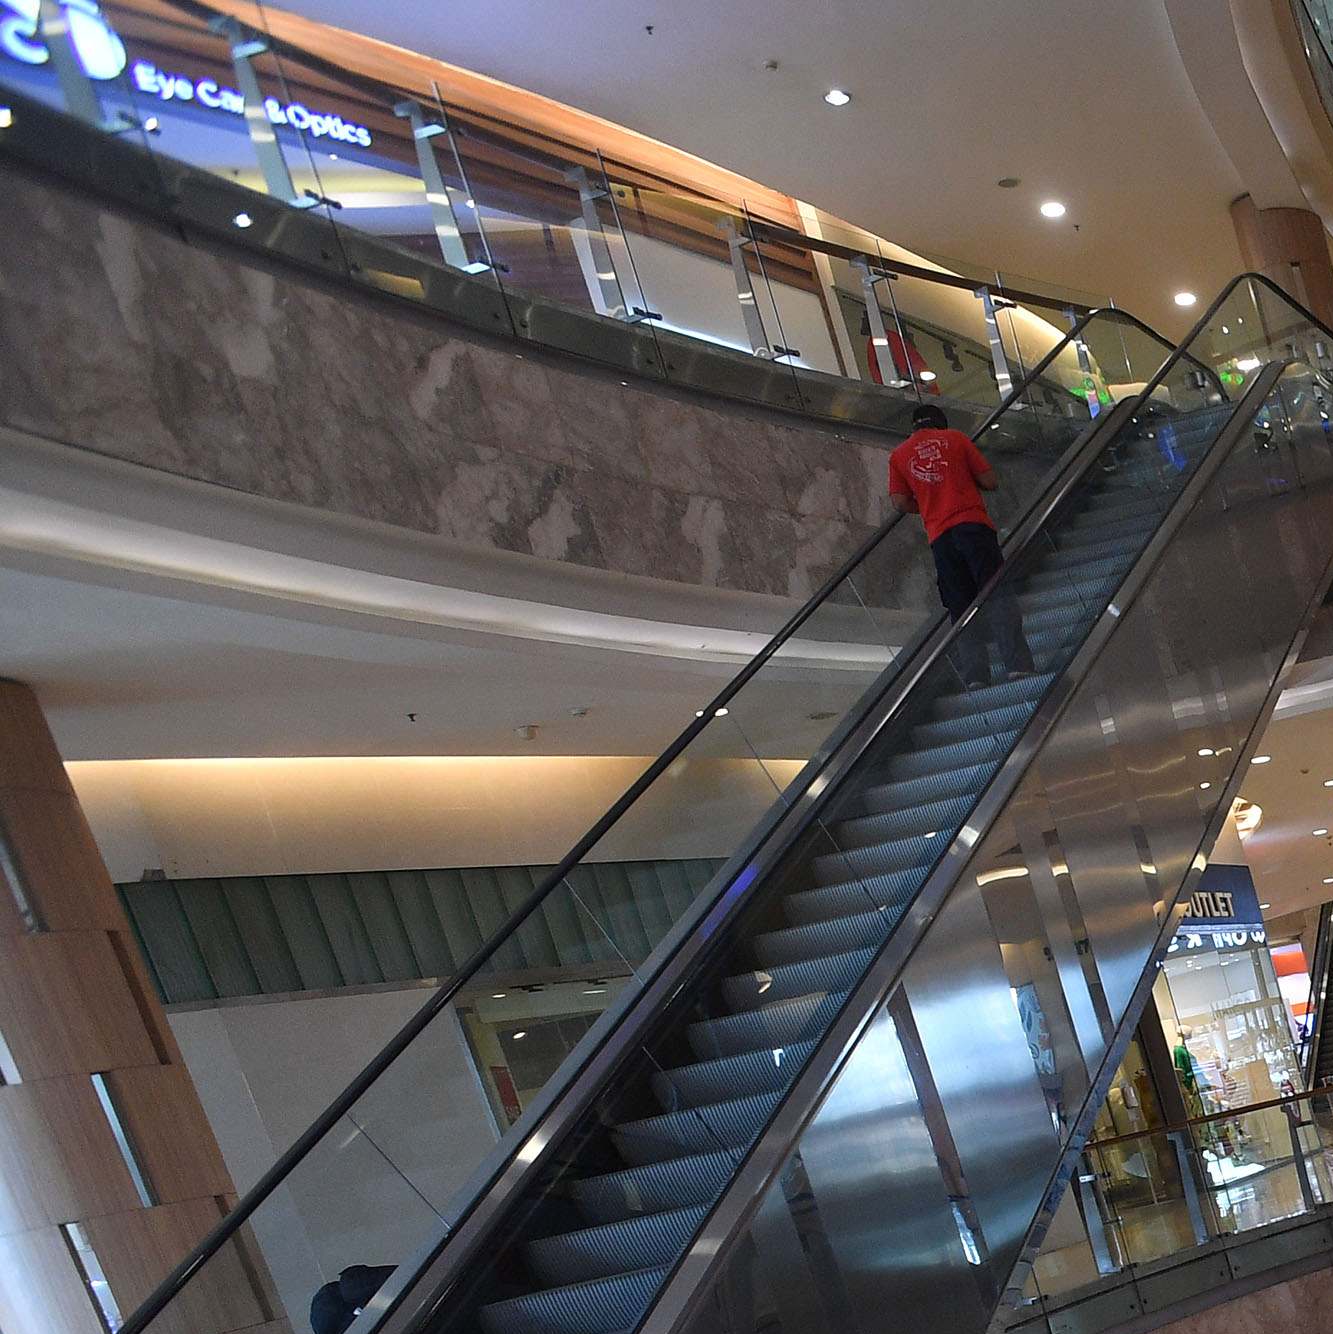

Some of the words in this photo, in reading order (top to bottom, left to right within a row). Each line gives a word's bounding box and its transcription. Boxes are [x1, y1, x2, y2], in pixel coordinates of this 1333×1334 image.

[130, 59, 194, 100] Eye
[197, 78, 245, 114] Car
[264, 97, 287, 125] &
[286, 102, 372, 147] Optics
